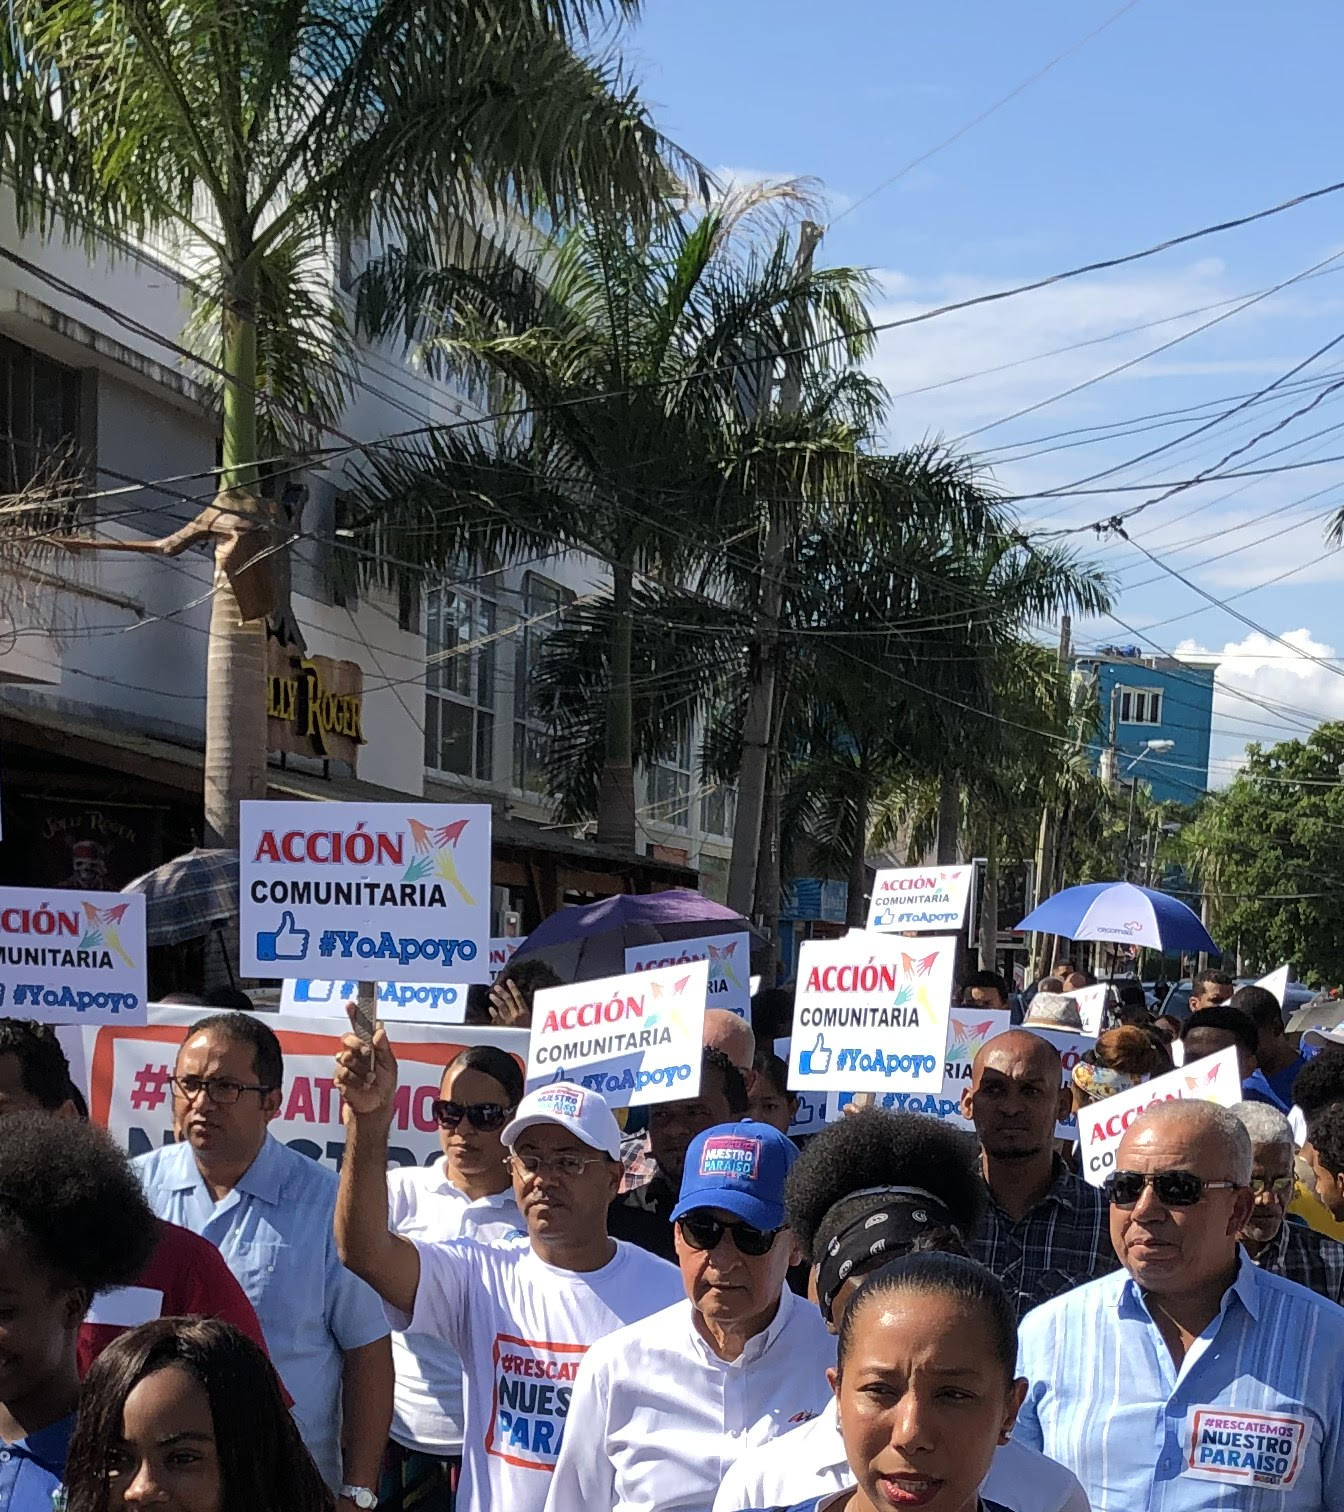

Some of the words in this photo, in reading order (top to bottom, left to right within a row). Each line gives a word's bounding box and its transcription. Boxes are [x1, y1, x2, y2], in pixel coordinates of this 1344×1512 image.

[252, 823, 404, 865] ACCIÓN
[250, 880, 447, 907] COMUNITARIA
[881, 875, 937, 892] ACCIÓN
[875, 894, 949, 906] COMUNITARIA
[318, 930, 477, 966] #YoApoyo
[805, 956, 897, 993] ACCIÓN
[13, 983, 138, 1013] #YoApoyo
[540, 991, 646, 1035] ACCIÓN
[800, 1007, 920, 1028] COMUNITARIA
[536, 1026, 672, 1065] COMUNITARIA
[836, 1049, 936, 1078] #YoApoyo
[706, 1149, 753, 1161] NUESTRO
[1204, 1418, 1294, 1438] #RESCATEMOS
[1201, 1429, 1292, 1455] NUESTRO
[1200, 1447, 1288, 1474] PARAÍSO
